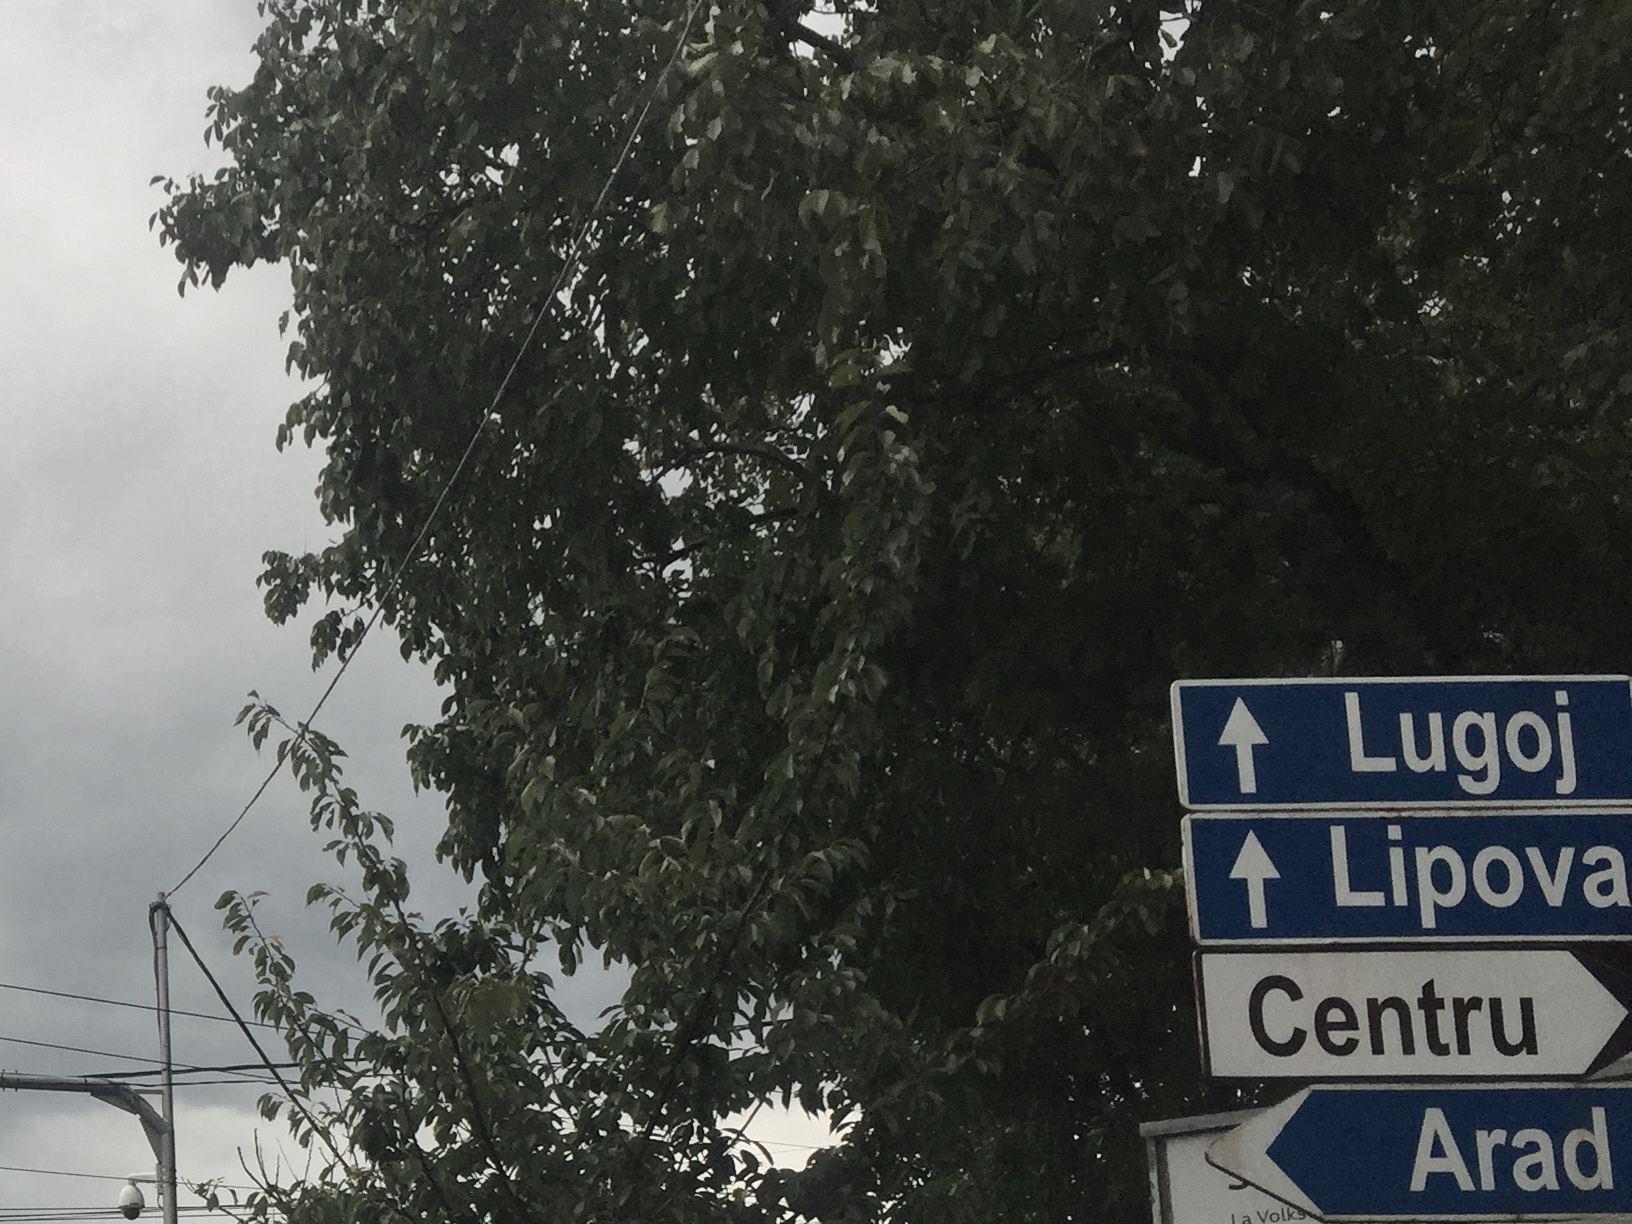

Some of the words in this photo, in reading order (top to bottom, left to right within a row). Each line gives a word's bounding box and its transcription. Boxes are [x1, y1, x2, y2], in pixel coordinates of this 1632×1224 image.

[1344, 690, 1577, 795] Lugoj
[1330, 824, 1632, 929] Lipova
[1248, 974, 1539, 1057] Centru
[1409, 1106, 1614, 1193] Arad
